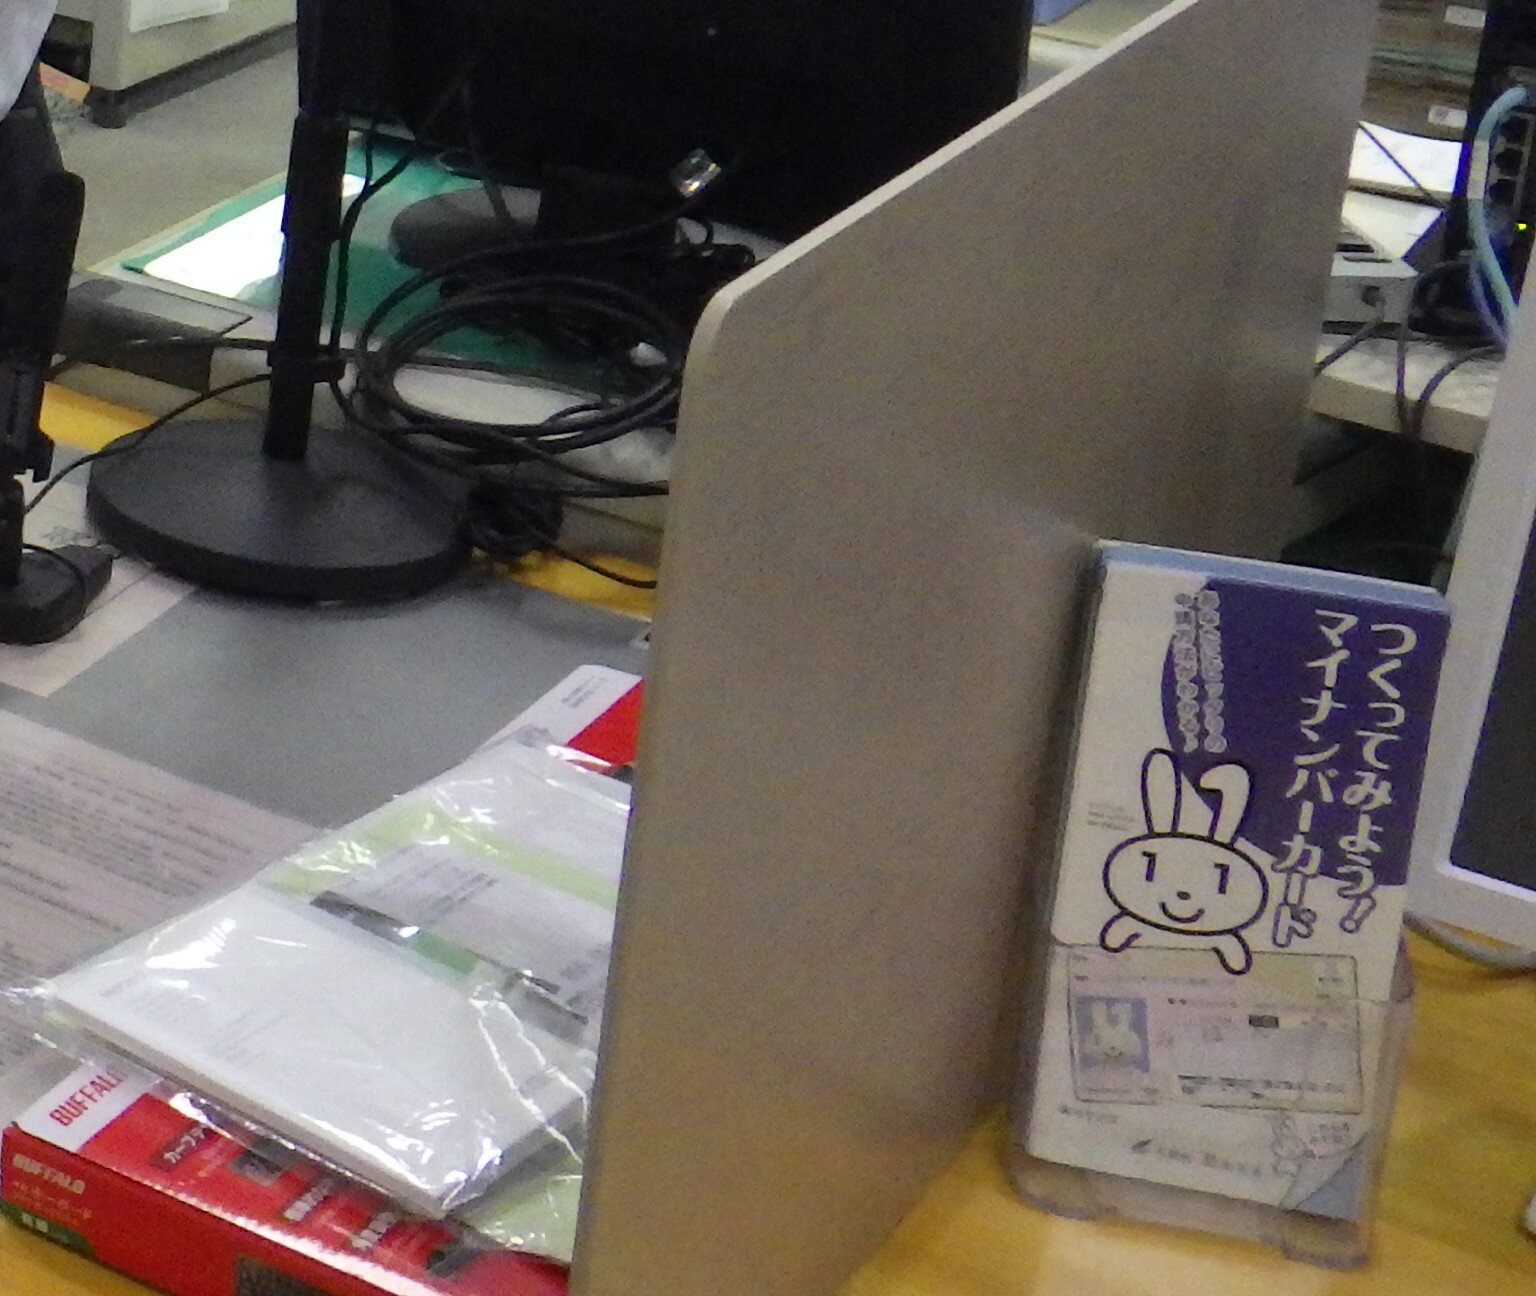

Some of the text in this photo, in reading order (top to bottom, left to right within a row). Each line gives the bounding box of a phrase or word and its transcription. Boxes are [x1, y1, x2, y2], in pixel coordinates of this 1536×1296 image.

[1270, 608, 1360, 949] マイナンバーカード
[12, 1154, 86, 1195] BUFFALO
